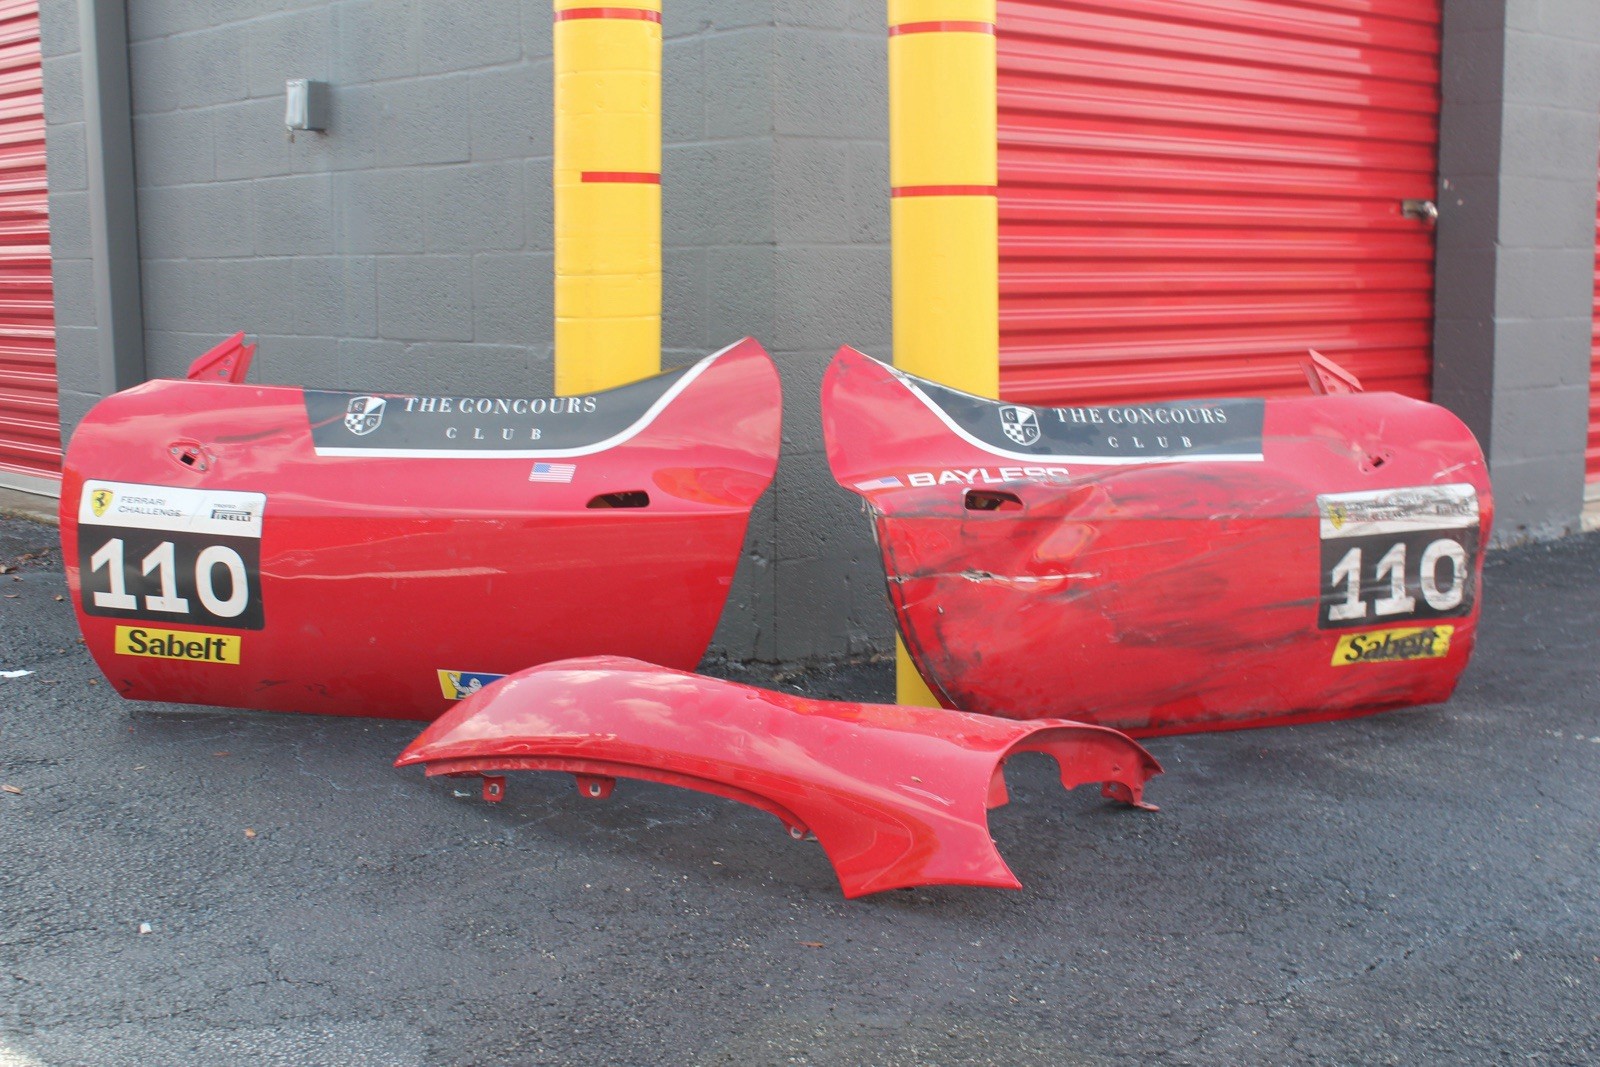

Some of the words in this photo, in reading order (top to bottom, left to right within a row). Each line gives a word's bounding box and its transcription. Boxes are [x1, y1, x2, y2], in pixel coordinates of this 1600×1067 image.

[404, 397, 451, 413] THE
[459, 397, 597, 414] CONCOURS
[1053, 408, 1103, 424] THE
[1108, 408, 1227, 424] CONCOURS
[446, 427, 542, 440] CLUB
[1108, 436, 1192, 448] CLUB
[120, 495, 166, 506] FERRARI
[118, 505, 181, 518] CHALLENGE
[210, 509, 252, 522] PIRELLI
[90, 537, 249, 618] 110
[1328, 538, 1468, 621] 110
[127, 629, 227, 661] Sabelt
